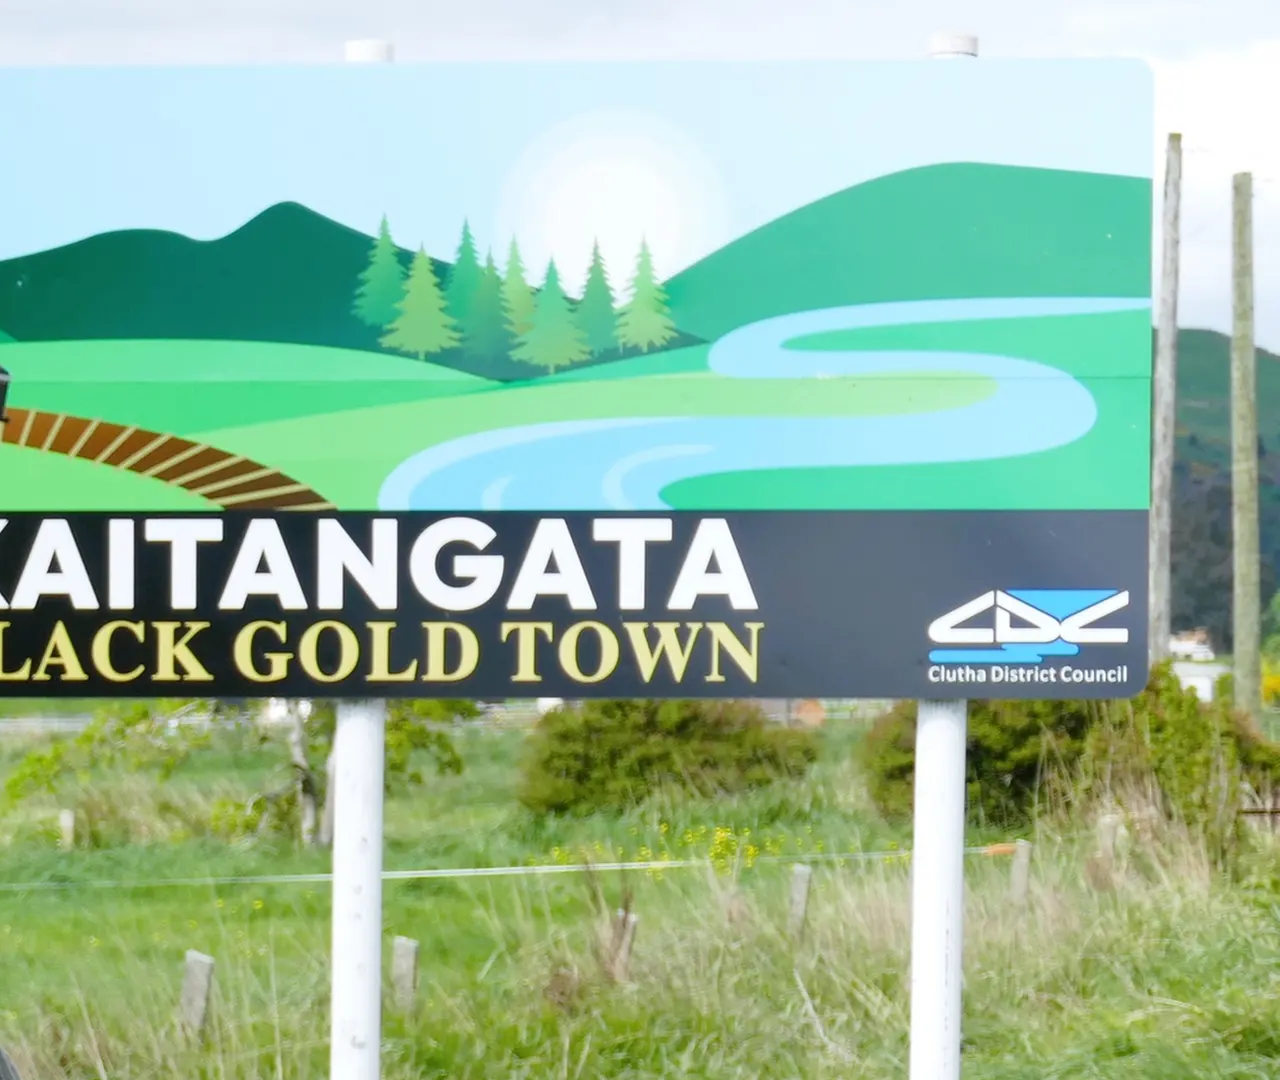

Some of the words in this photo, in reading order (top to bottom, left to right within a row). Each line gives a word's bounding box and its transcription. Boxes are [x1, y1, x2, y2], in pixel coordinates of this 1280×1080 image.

[234, 620, 479, 682] GOLD
[500, 621, 765, 683] TOWN
[927, 665, 987, 683] Clutha
[990, 665, 1057, 683] District
[1060, 665, 1128, 683] Council
